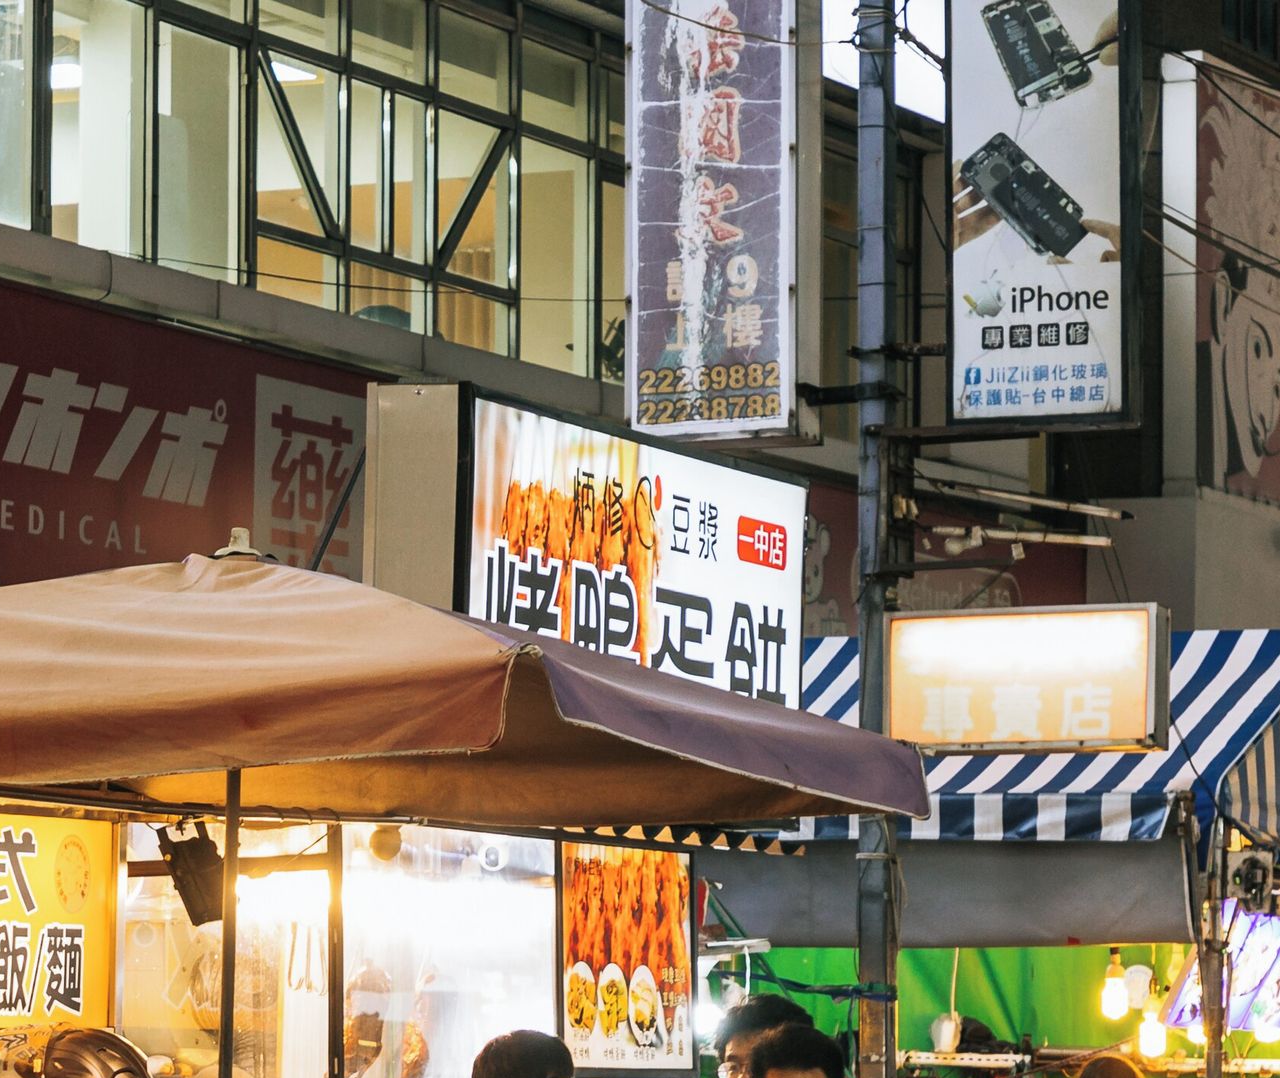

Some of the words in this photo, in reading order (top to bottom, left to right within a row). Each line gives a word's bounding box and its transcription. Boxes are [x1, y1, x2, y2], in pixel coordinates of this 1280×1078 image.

[1011, 285, 1109, 313] iPhone
[982, 322, 1089, 349] 專業維修
[738, 524, 785, 568] 一中店
